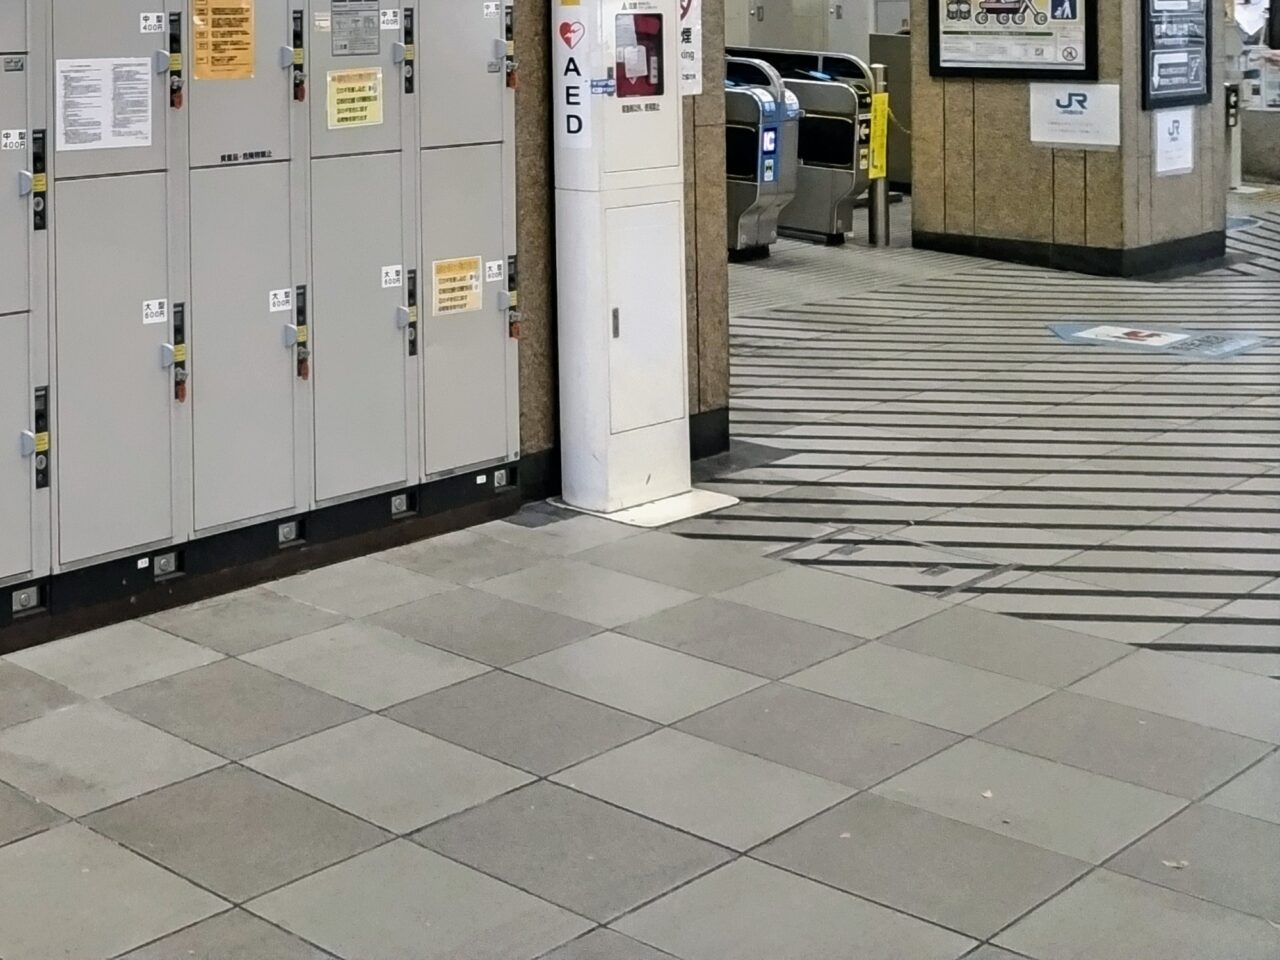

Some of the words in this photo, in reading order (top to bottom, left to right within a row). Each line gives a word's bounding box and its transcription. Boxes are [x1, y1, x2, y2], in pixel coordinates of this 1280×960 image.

[564, 57, 583, 135] AED
[1056, 92, 1088, 110] JR
[1168, 120, 1180, 137] JR
